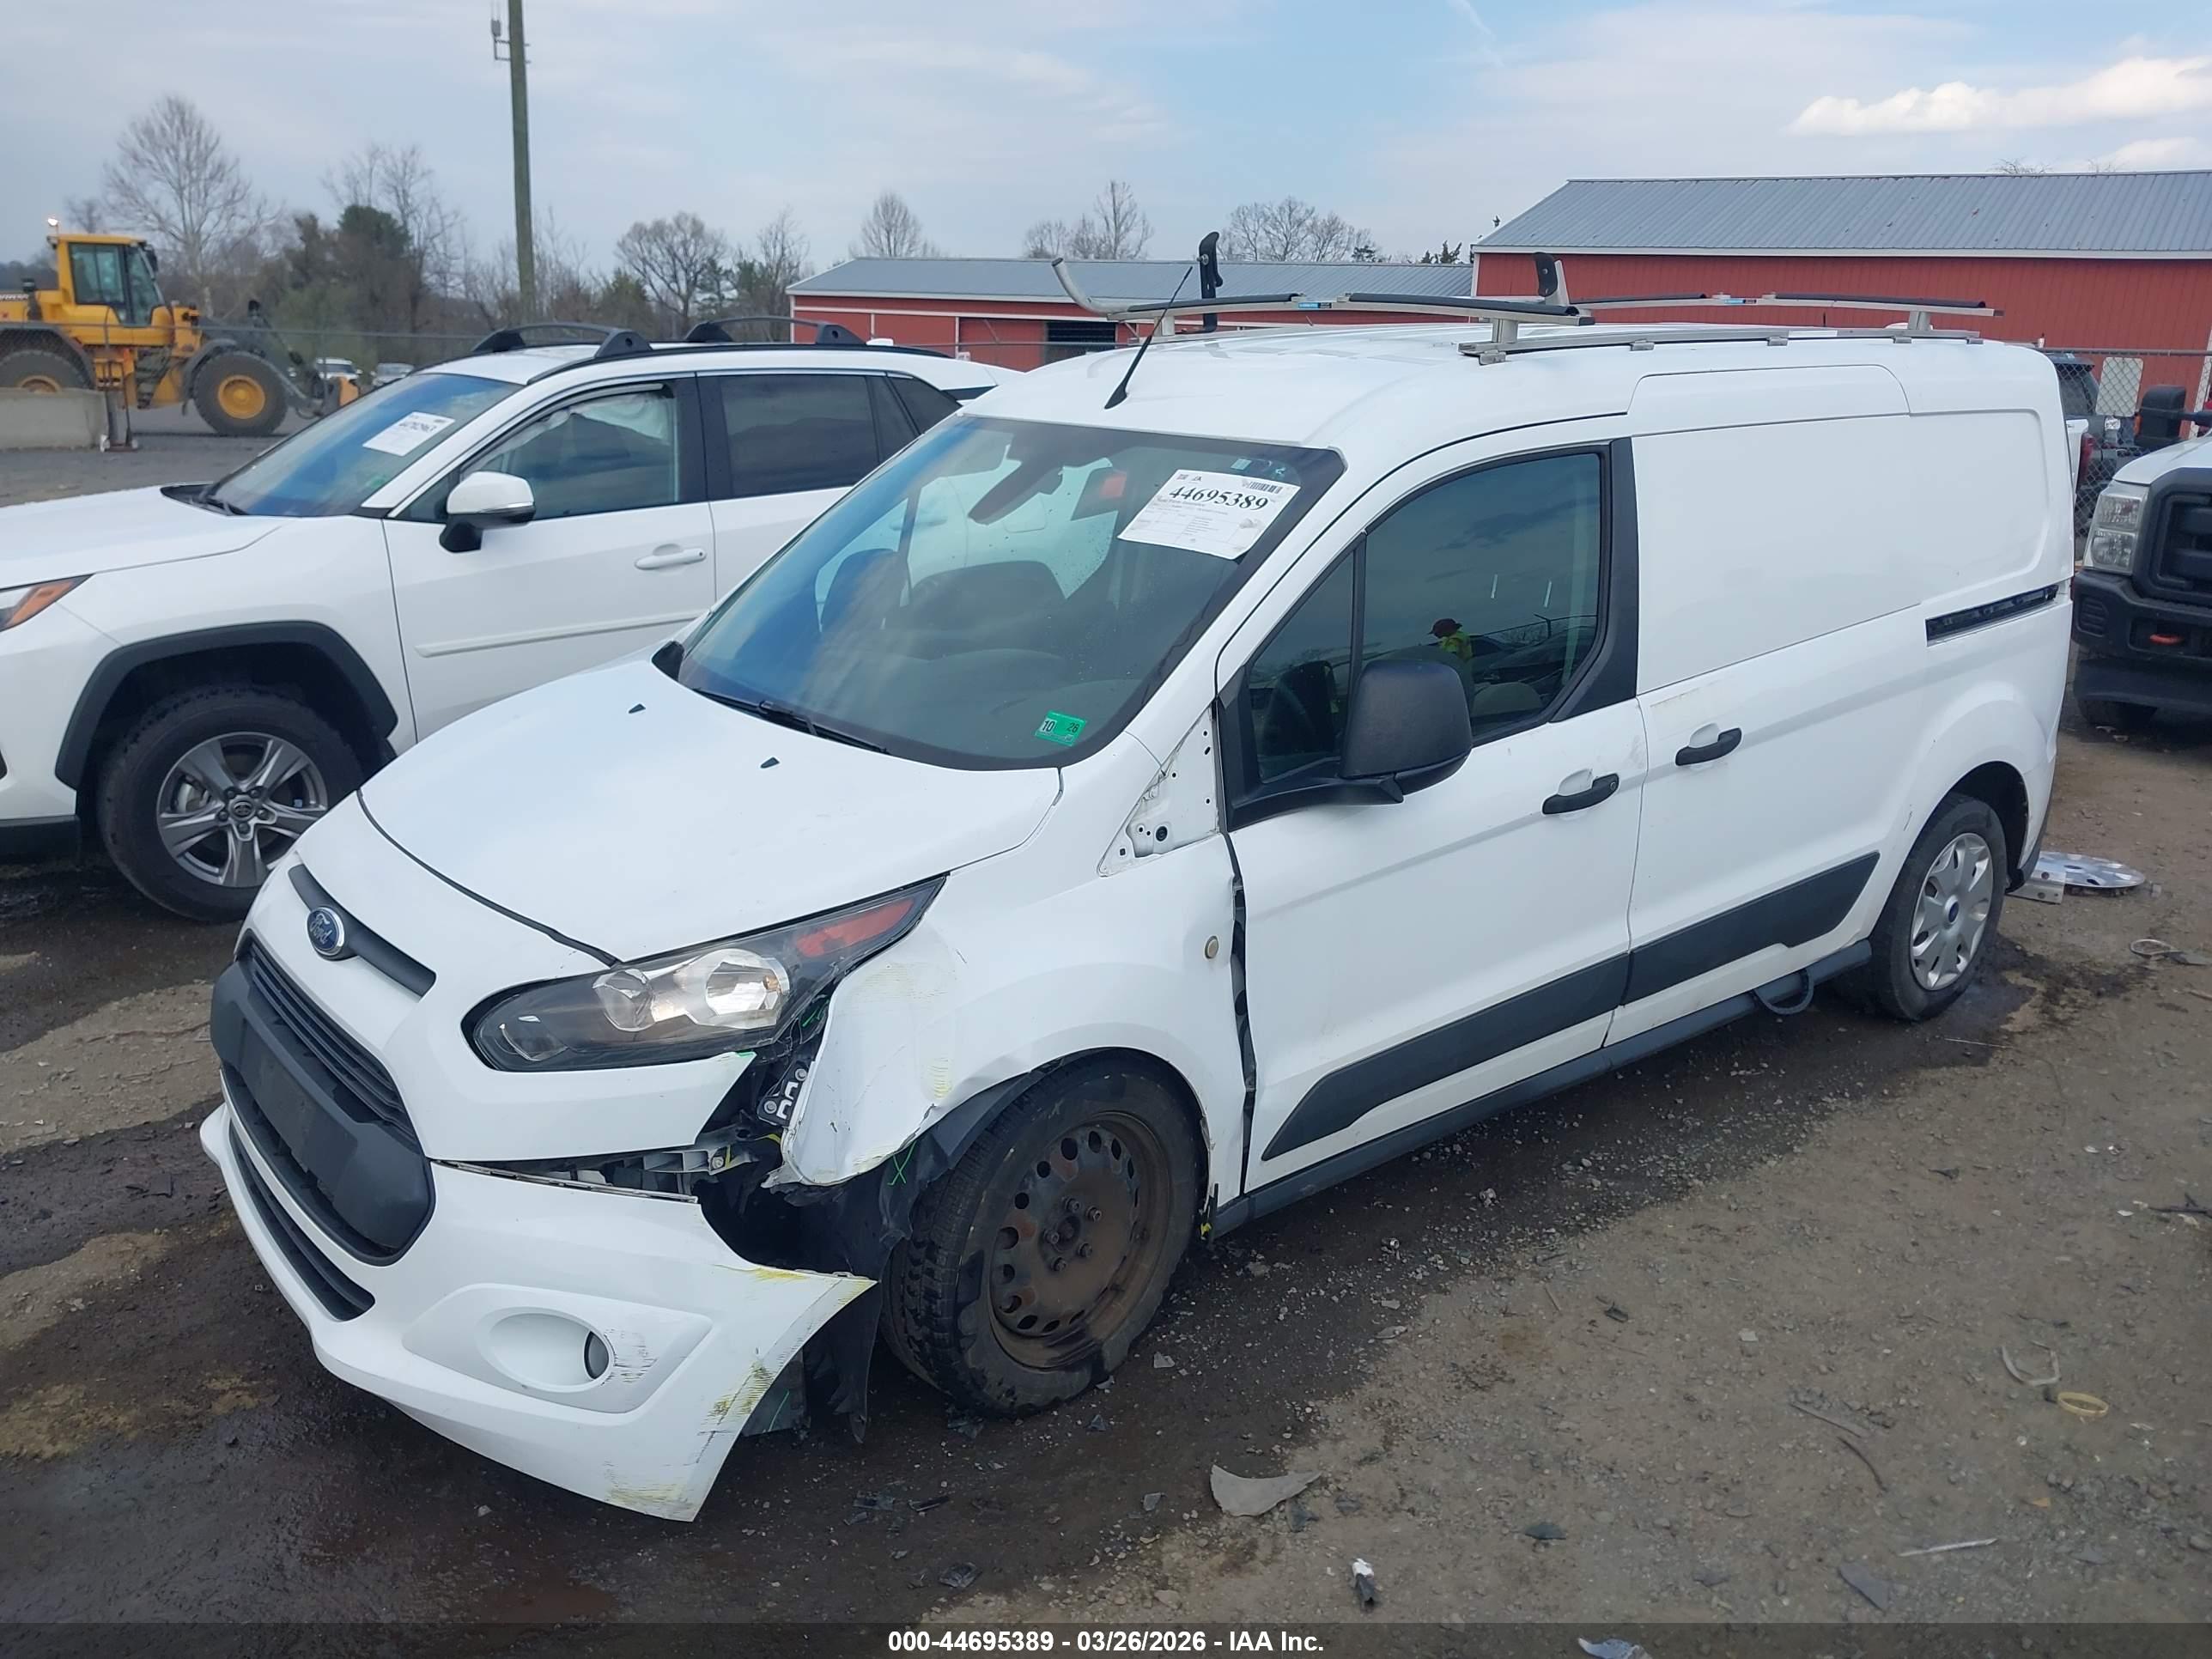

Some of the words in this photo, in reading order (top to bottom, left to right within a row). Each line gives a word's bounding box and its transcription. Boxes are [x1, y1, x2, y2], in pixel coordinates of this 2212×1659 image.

[1169, 486, 1269, 511] 44695389
[1042, 720, 1055, 732] 10
[310, 913, 333, 945] Ford
